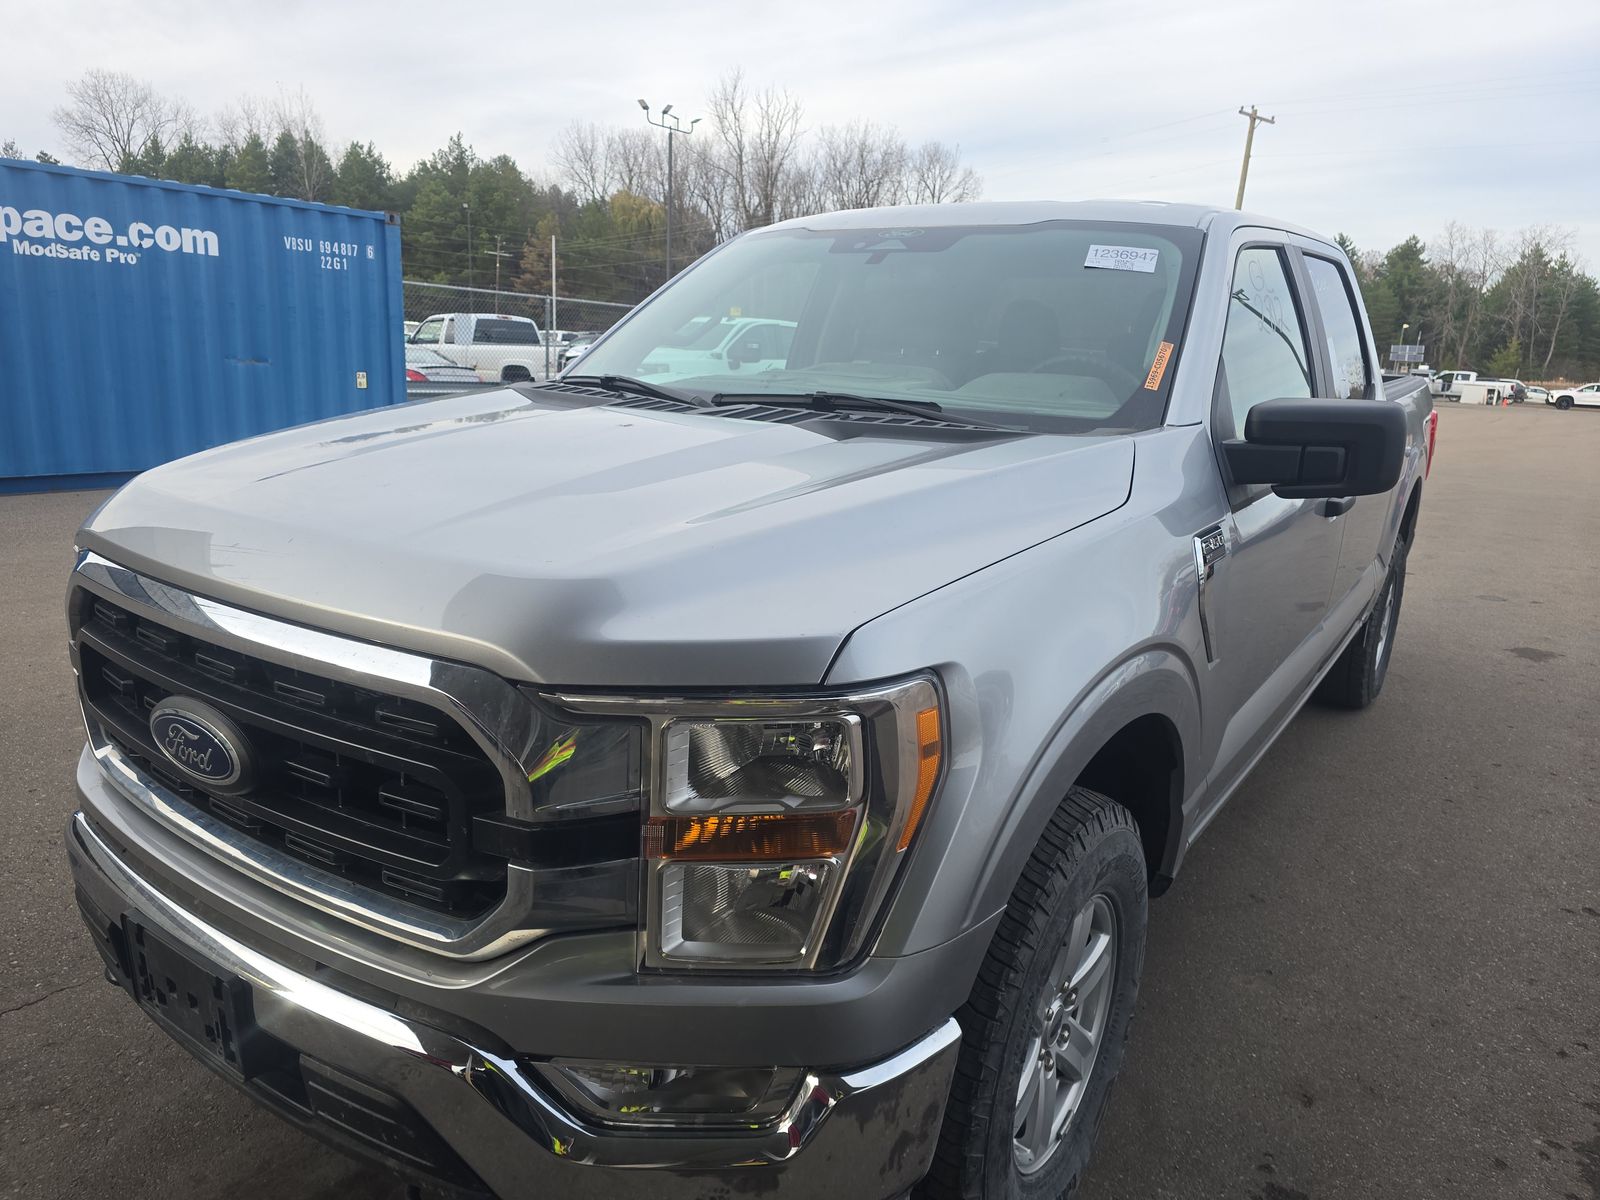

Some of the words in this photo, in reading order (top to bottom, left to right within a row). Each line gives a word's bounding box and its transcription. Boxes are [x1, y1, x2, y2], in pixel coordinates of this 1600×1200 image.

[13, 239, 100, 261] ModSafe
[1092, 248, 1157, 262] 1236947
[320, 255, 347, 270] 22G1
[165, 723, 213, 772] Ford
